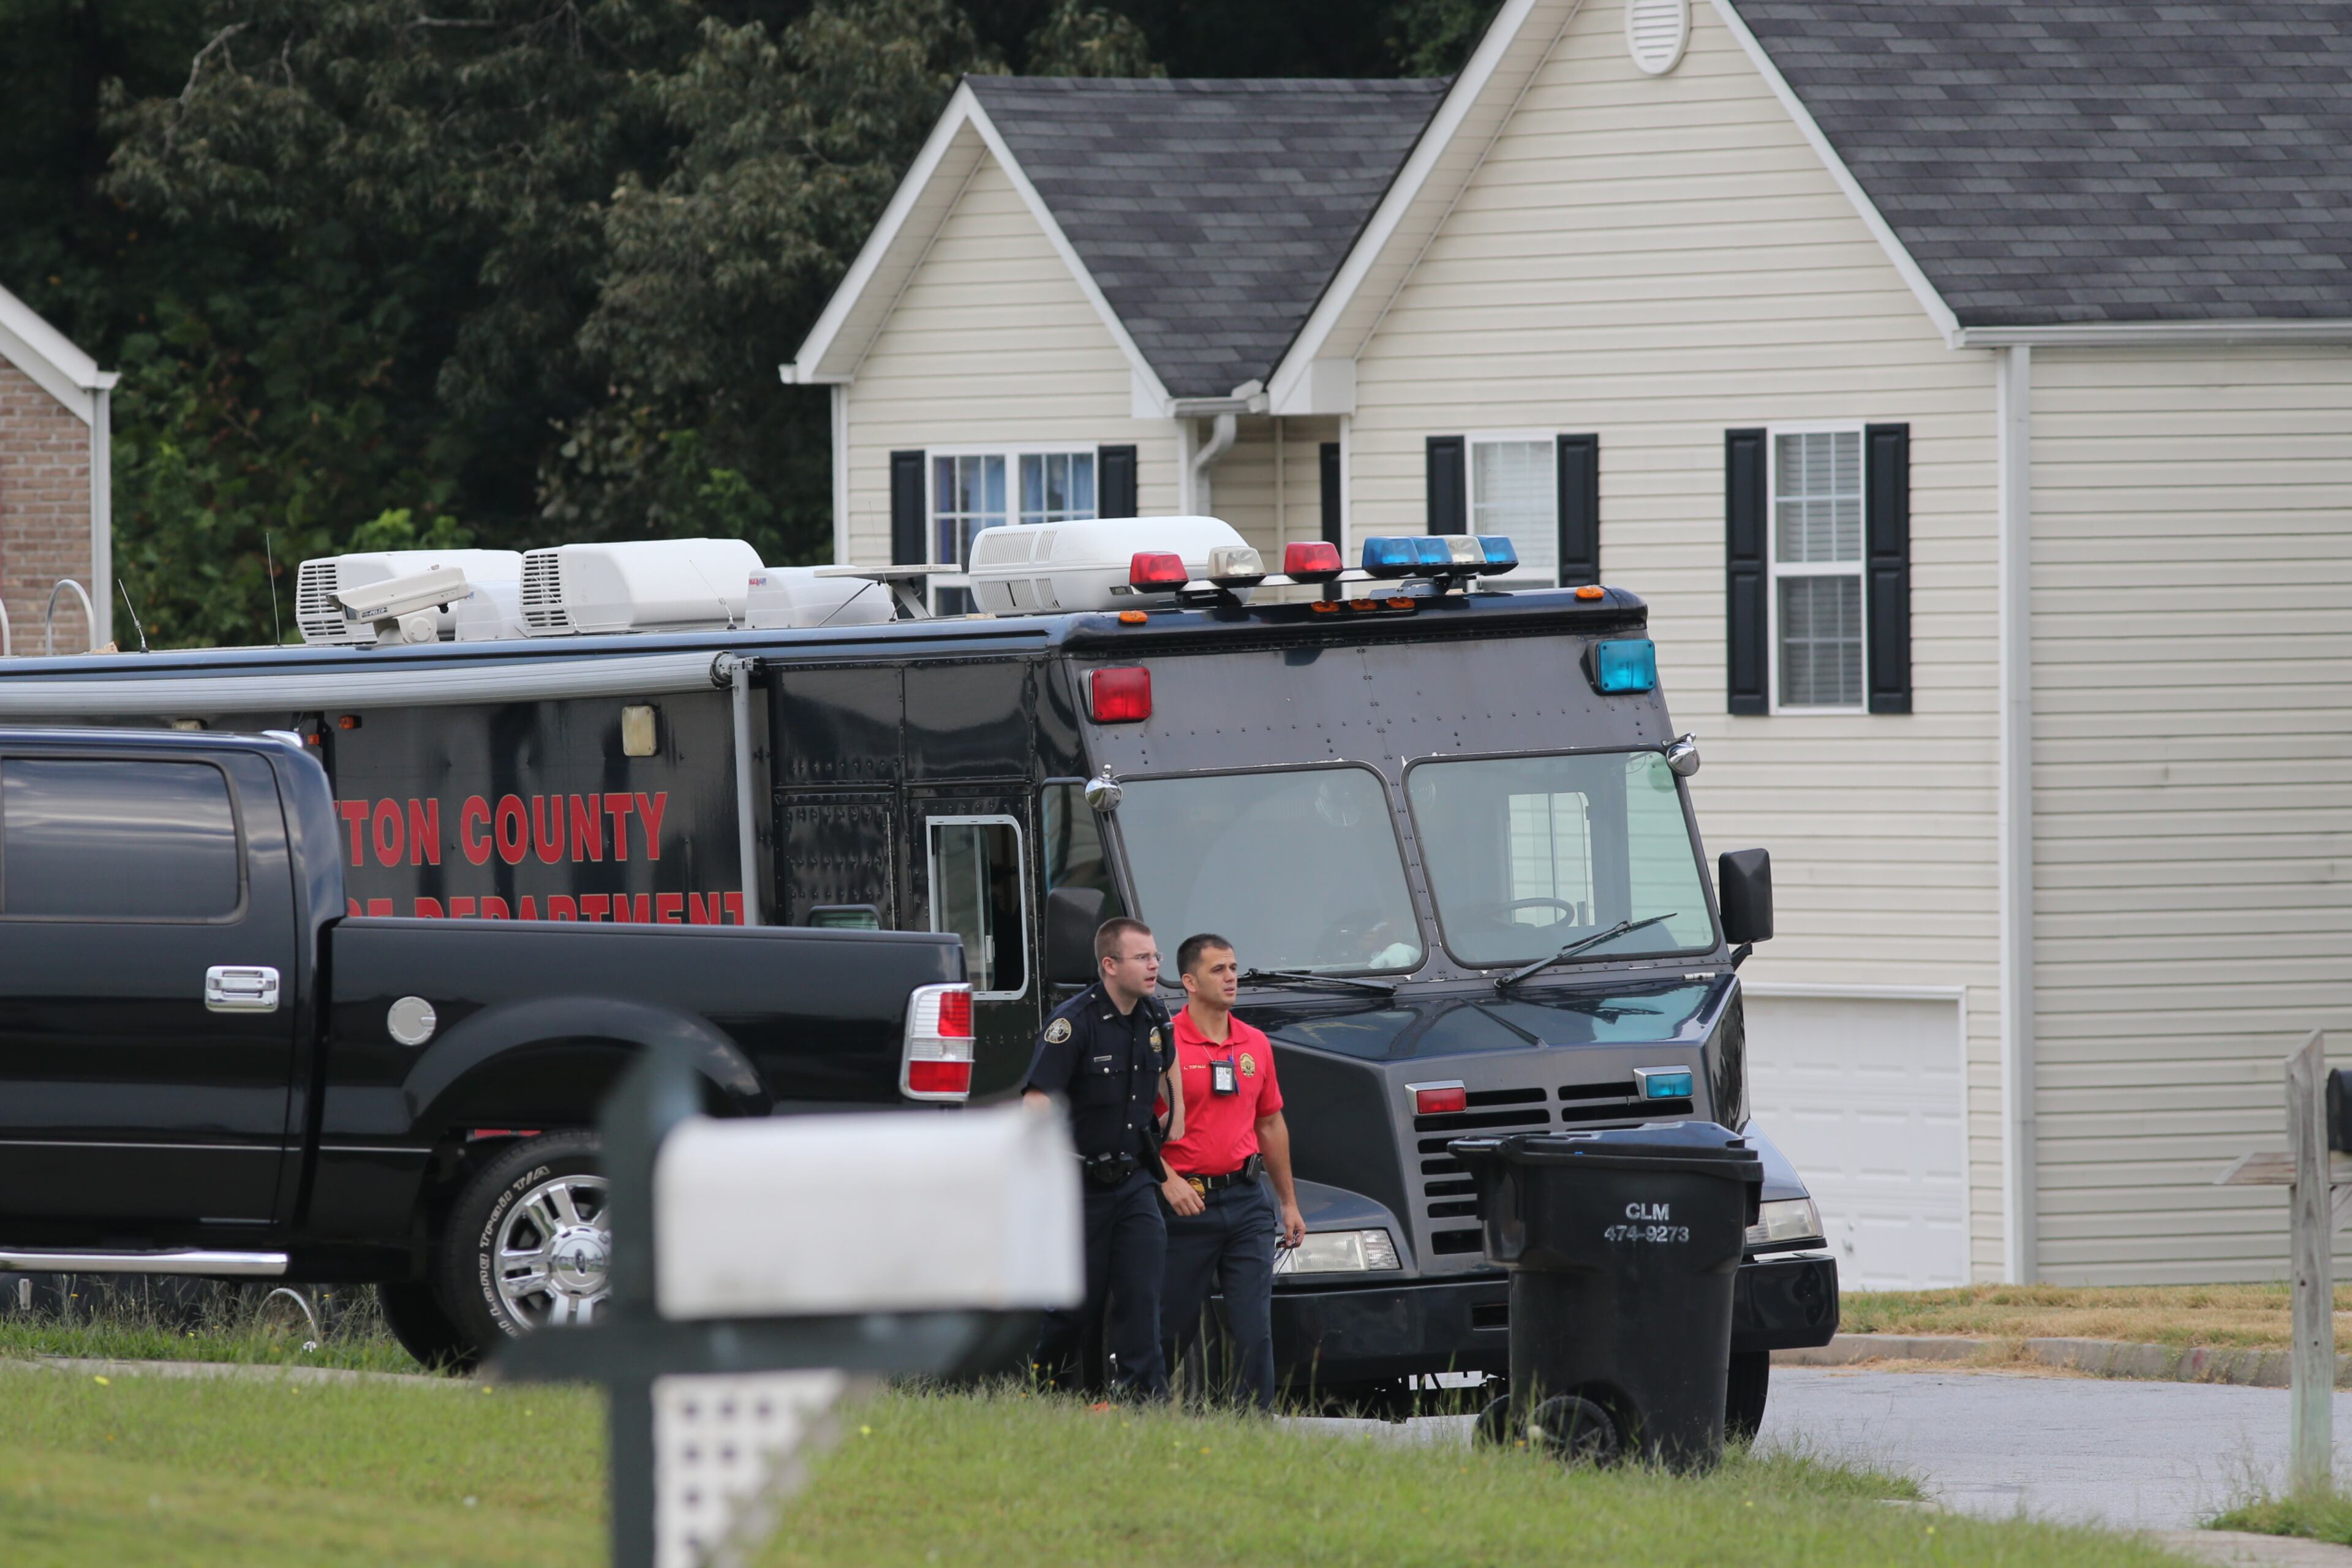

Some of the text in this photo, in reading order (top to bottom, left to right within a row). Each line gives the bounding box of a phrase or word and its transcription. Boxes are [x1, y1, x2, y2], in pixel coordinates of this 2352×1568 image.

[334, 792, 668, 867] TON COUNTY
[1604, 1224, 1689, 1243] 474-9273
[1625, 1202, 1670, 1221] CLM
[479, 1166, 551, 1317] Long Trail T/A
